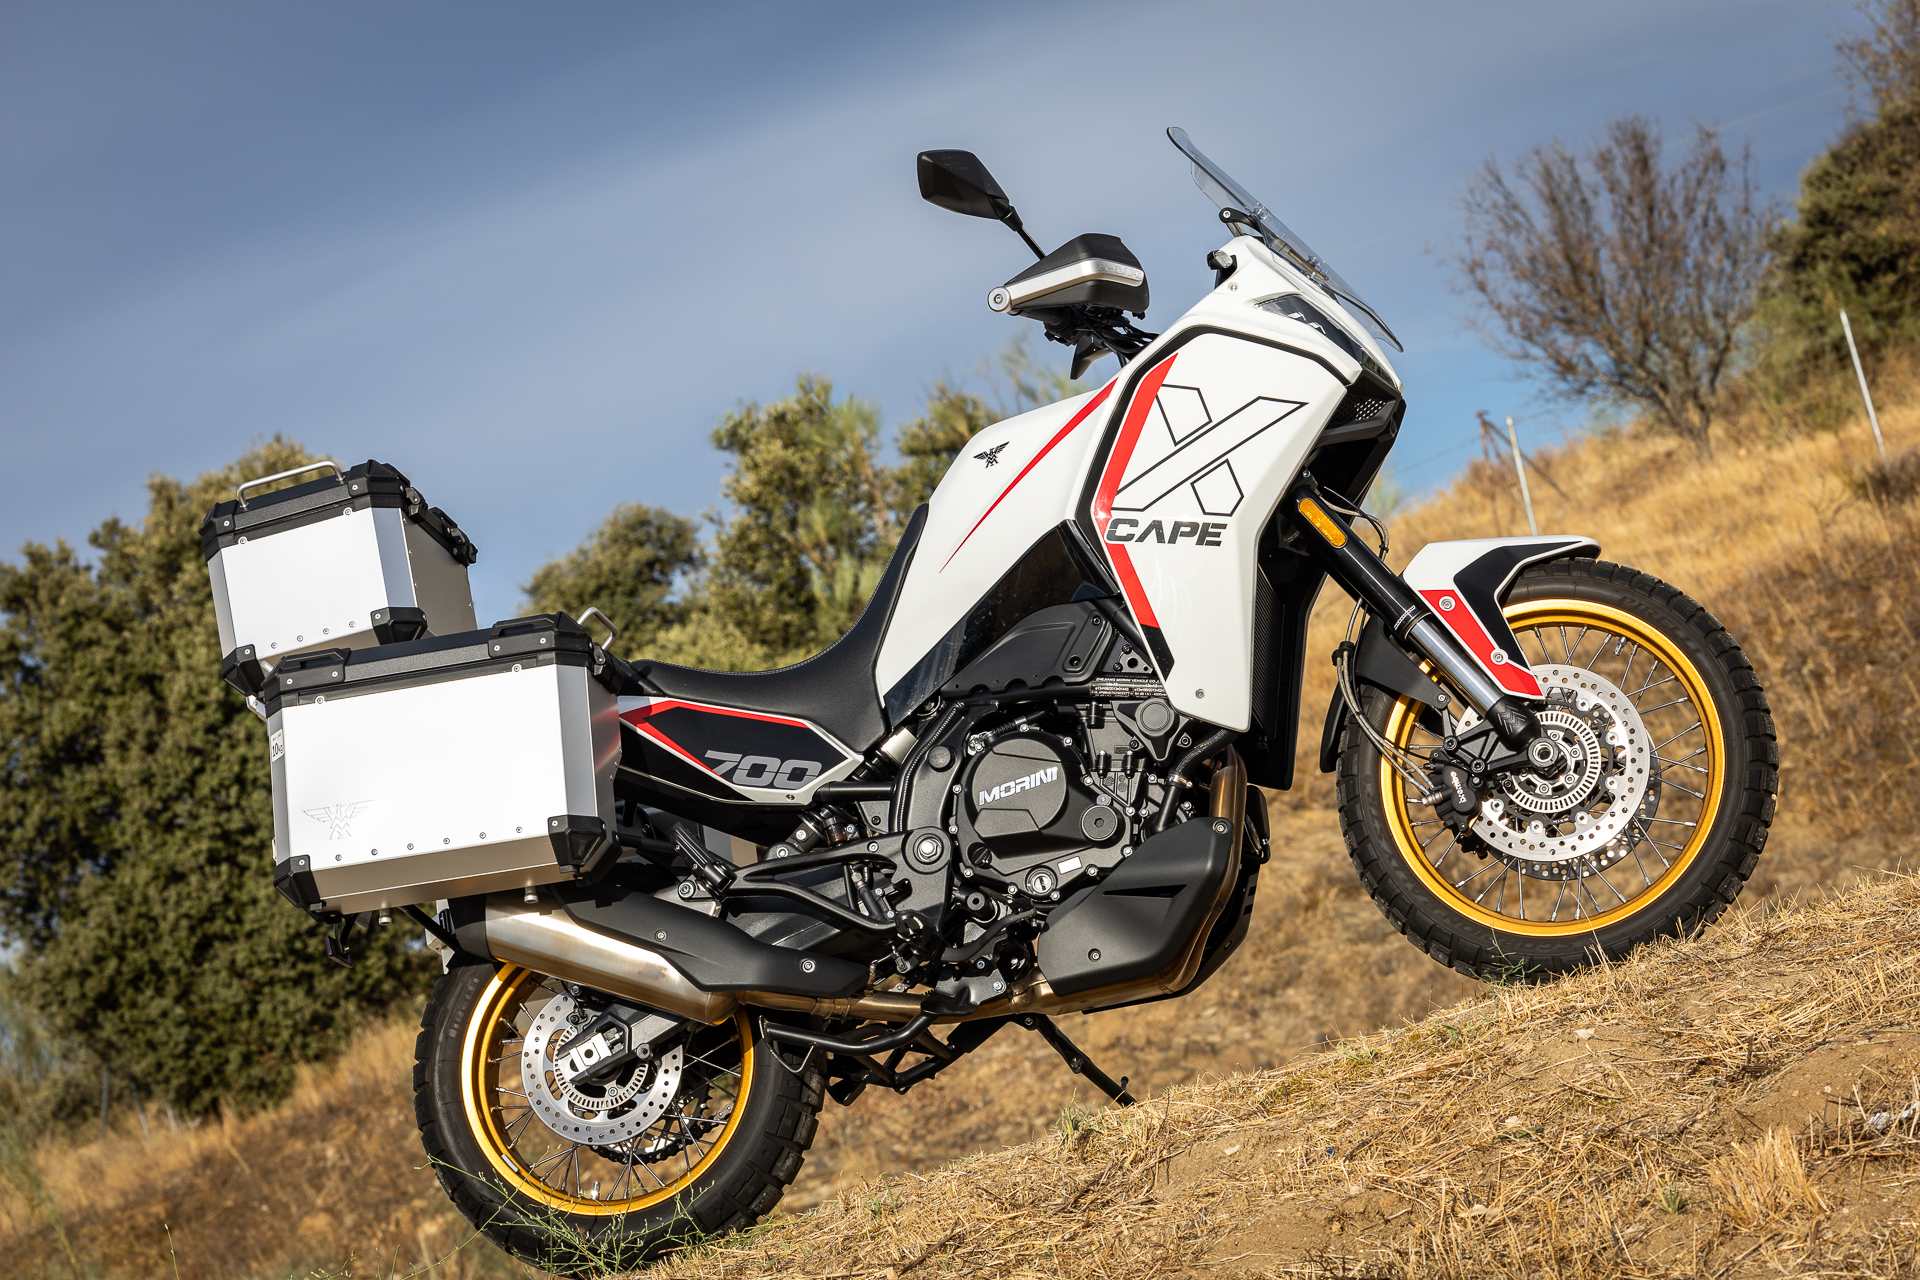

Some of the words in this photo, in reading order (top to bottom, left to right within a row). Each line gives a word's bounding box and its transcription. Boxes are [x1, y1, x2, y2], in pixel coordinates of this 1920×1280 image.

[1106, 518, 1227, 546] CAPE
[1616, 595, 1702, 655] PIRELLI
[704, 749, 822, 790] 700
[979, 766, 1058, 806] MORINI
[1450, 771, 1467, 804] brembo
